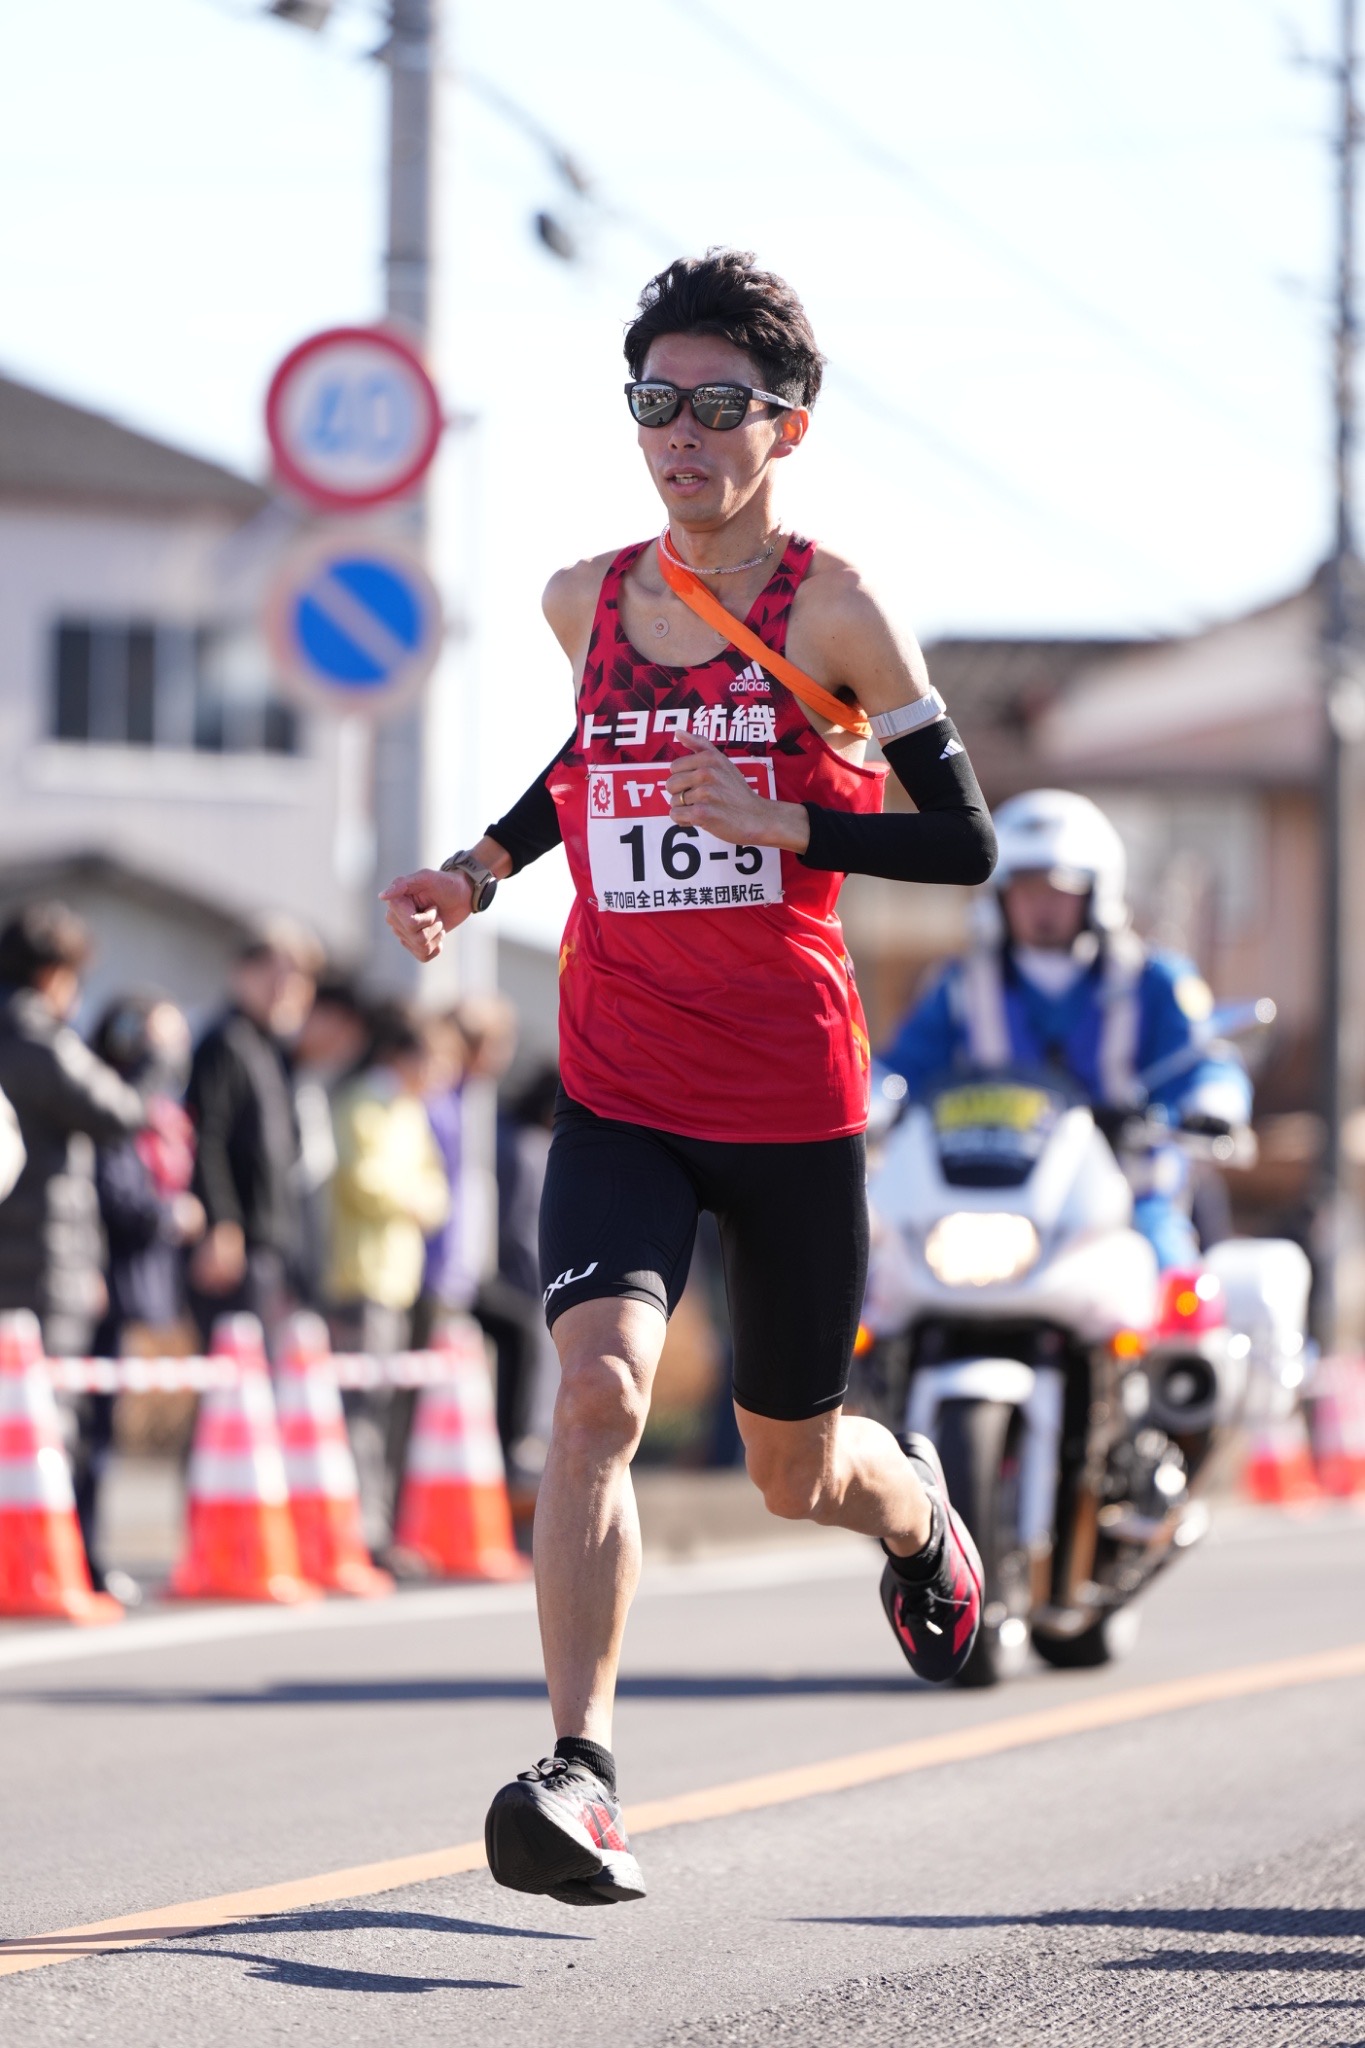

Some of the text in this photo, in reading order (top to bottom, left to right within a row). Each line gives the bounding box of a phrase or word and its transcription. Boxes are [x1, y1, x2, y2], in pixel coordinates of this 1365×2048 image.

[729, 679, 771, 692] adidas
[582, 703, 778, 750] トヨタ紡織
[619, 824, 764, 883] 16-5
[603, 883, 765, 910] 第70回全日本実業団駅伝
[542, 1261, 599, 1310] XU
